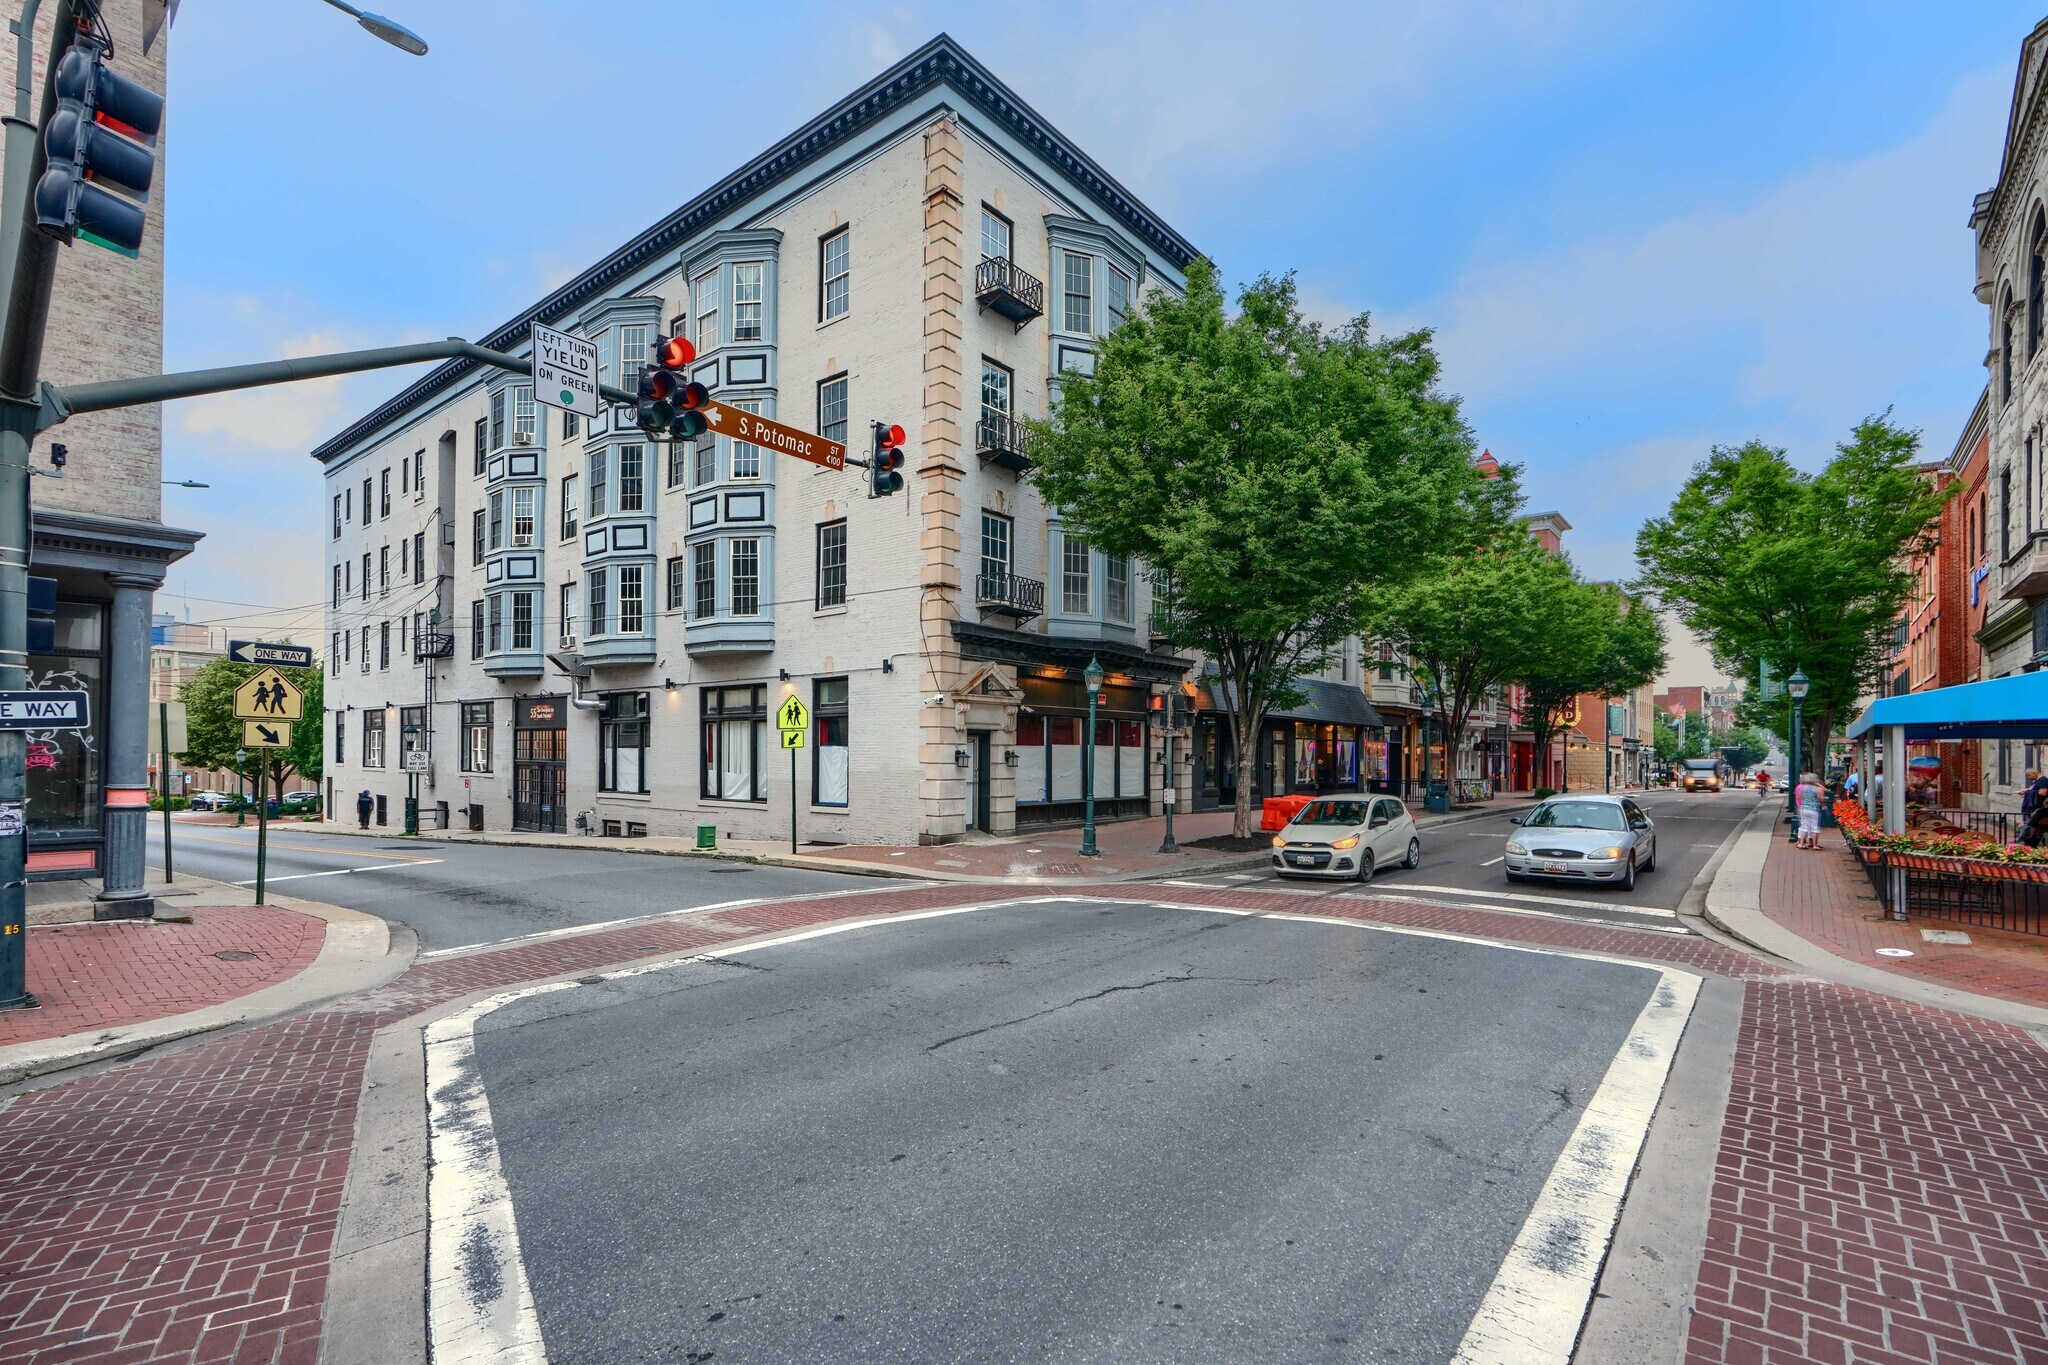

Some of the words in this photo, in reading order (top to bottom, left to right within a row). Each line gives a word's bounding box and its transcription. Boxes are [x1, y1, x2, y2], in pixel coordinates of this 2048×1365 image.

[537, 329, 561, 347] LEFT
[568, 340, 594, 358] TURN
[542, 344, 588, 370] YIELD
[539, 367, 553, 381] ON
[561, 374, 594, 394] GREEN
[739, 417, 750, 436] S.
[755, 422, 812, 455] Potomac
[830, 445, 839, 455] ST
[255, 649, 277, 658] ONE
[281, 651, 304, 660] WAY
[25, 702, 69, 717] WAY
[530, 708, 537, 718] 55
[4, 924, 19, 935] 15
